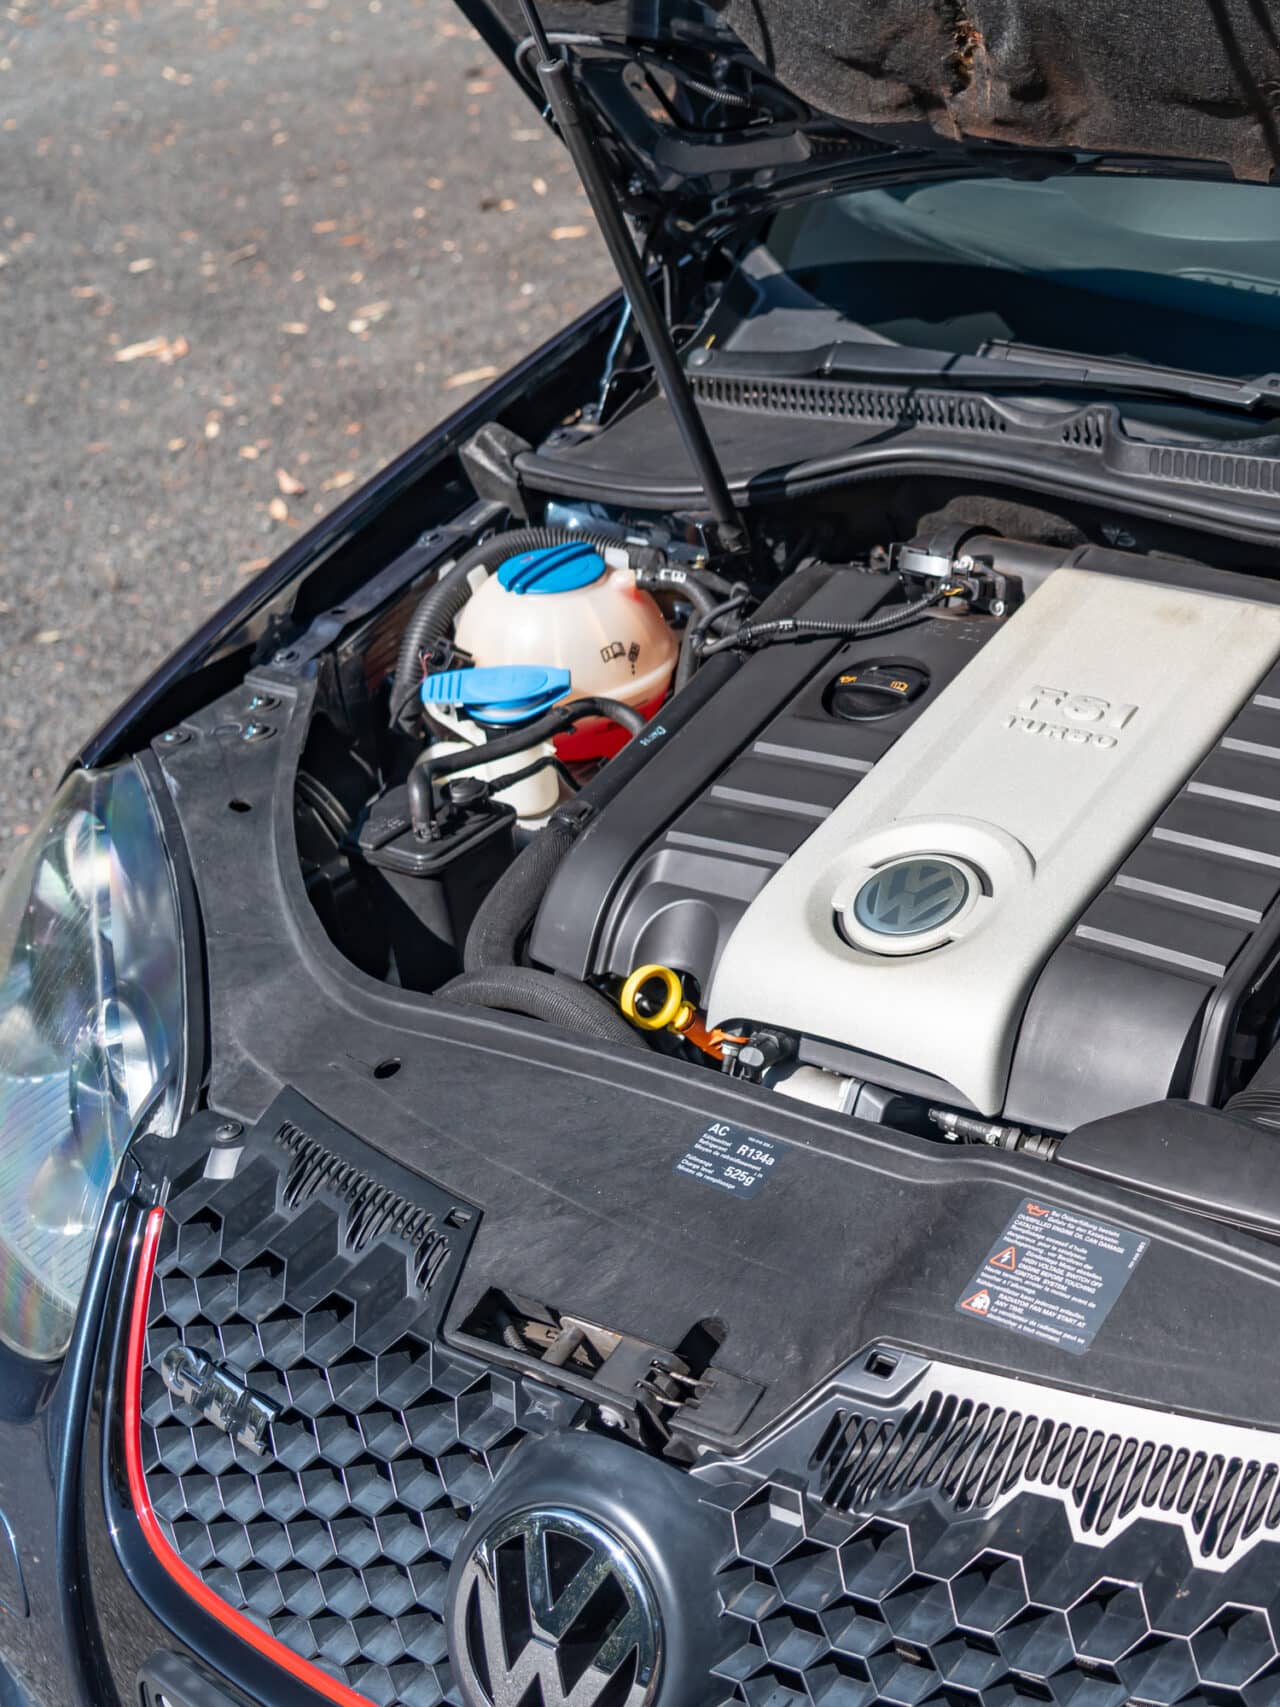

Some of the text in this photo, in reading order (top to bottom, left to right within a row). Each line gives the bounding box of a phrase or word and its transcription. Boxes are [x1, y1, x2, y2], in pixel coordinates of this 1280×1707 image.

[1018, 685, 1140, 731] FSI
[1003, 714, 1119, 749] TURBO
[708, 1123, 730, 1136] AC
[737, 1145, 774, 1165] R134a
[724, 1166, 755, 1186] 525g
[1014, 1220, 1043, 1232] CATALYST
[1018, 1214, 1051, 1228] OVERFILLED
[1052, 1225, 1073, 1235] ENGINE
[1084, 1236, 1098, 1244] CAN
[1098, 1241, 1124, 1253] DAMAGE
[1014, 1269, 1041, 1281] IGNITION
[1018, 1263, 1096, 1293] ENGINE BEFORE TOUCHING
[1022, 1257, 1038, 1265] HIGH
[1066, 1272, 1090, 1283] SWITCH
[1090, 1280, 1103, 1288] OFF
[998, 1293, 1028, 1307] RADIATOR
[1029, 1304, 1042, 1312] FAN
[1042, 1309, 1056, 1317] MAY
[1056, 1314, 1077, 1324] START
[161, 1344, 279, 1456] GTI
